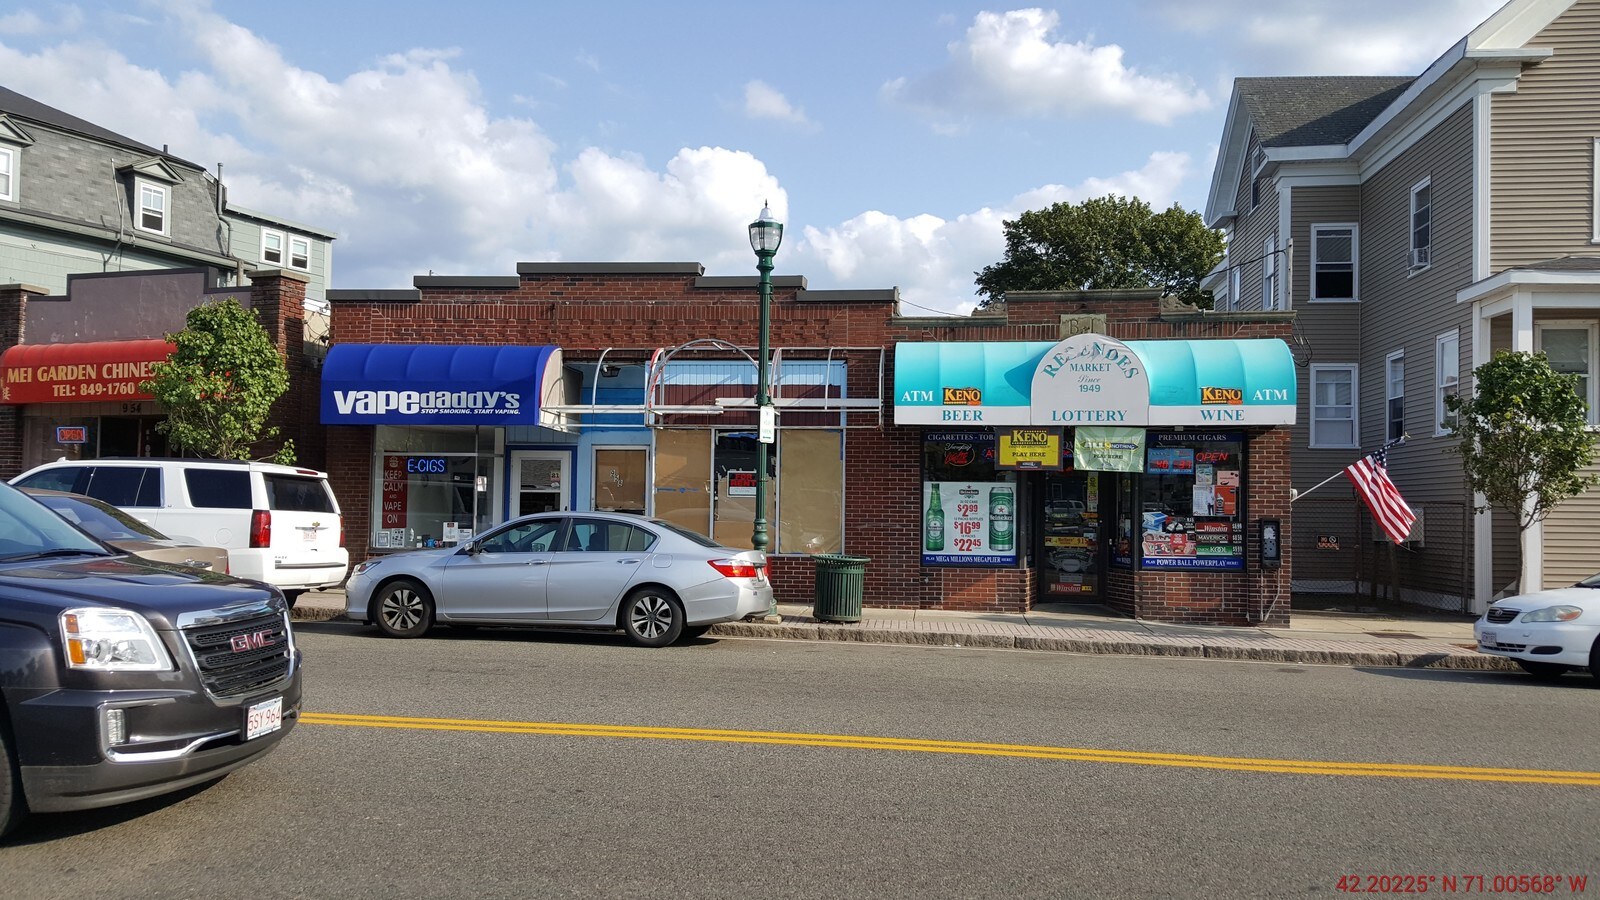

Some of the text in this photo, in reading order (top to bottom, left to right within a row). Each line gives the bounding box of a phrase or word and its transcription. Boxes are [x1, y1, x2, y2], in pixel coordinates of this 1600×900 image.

[1069, 363, 1111, 372] MARKET
[7, 367, 32, 383] MEI
[37, 364, 97, 381] GARDEN
[1077, 375, 1101, 383] Since
[52, 382, 134, 397] TEL: 849-1760
[1079, 384, 1101, 393] 1949
[1201, 387, 1241, 401] KENO
[901, 390, 934, 402] ATM
[944, 387, 981, 402] KENO
[1252, 389, 1288, 401] ATM
[942, 410, 983, 421] BEER
[1052, 410, 1127, 422] LOTTERY
[1200, 410, 1244, 421] WINE
[59, 429, 84, 441] OPEN
[1013, 430, 1047, 442] KENO
[1195, 451, 1229, 462] OPEN
[407, 458, 445, 473] E-CIGS
[384, 470, 402, 479] KEEP
[383, 482, 403, 492] CALM
[384, 501, 402, 511] VAPE
[387, 514, 398, 524] ON
[1156, 558, 1177, 566] POWER
[1056, 584, 1081, 592] Winston
[230, 629, 275, 653] GMC
[265, 706, 281, 726] 964
